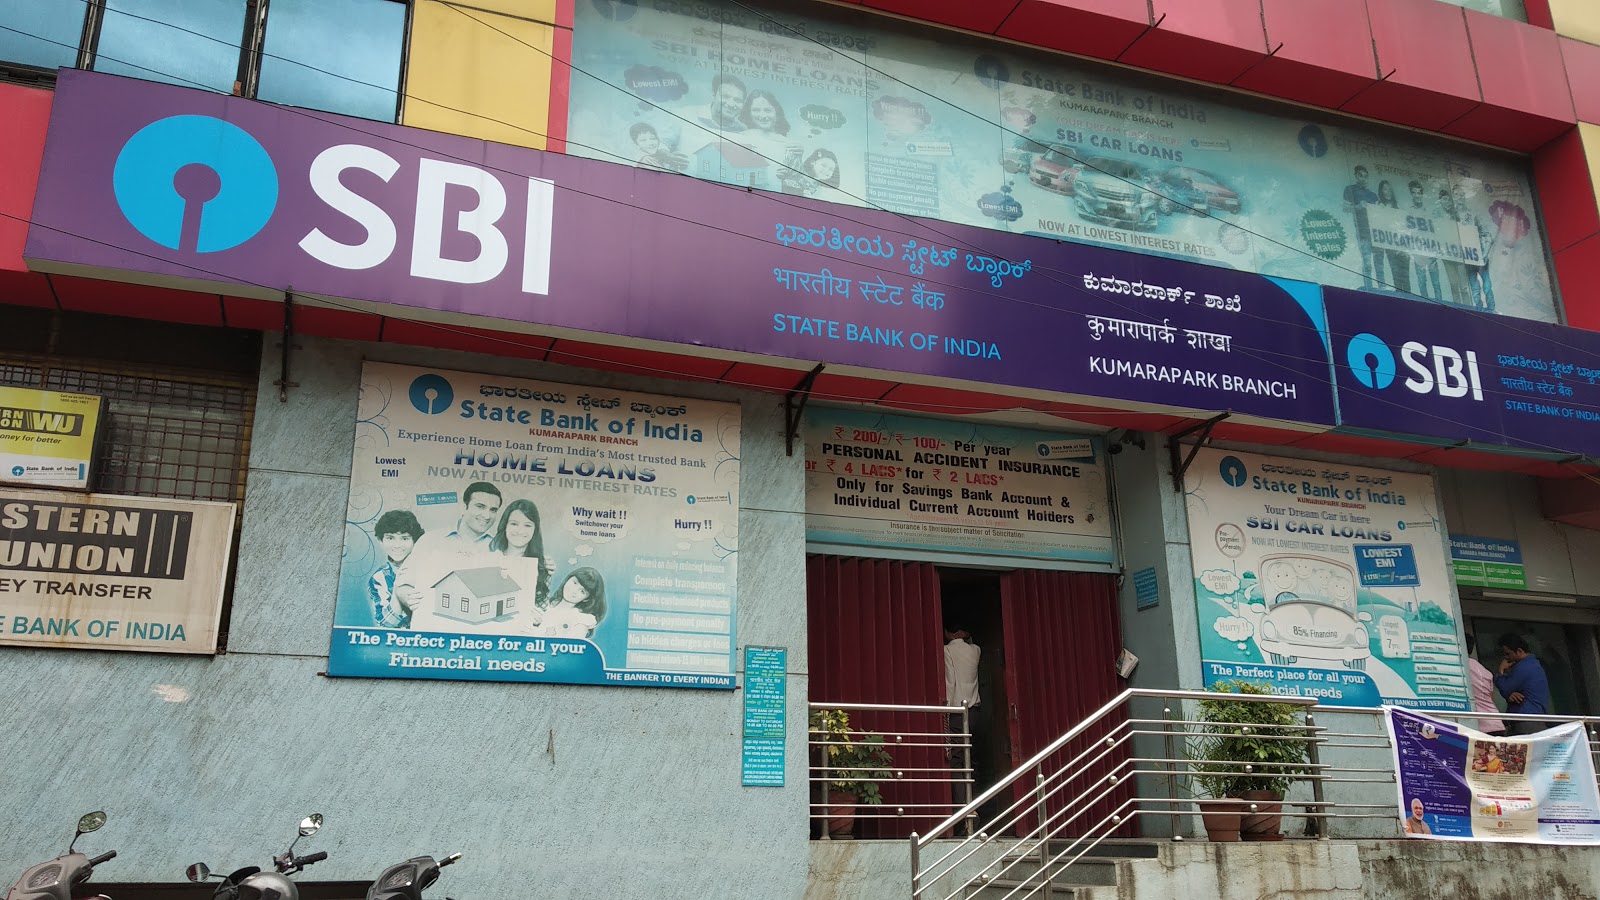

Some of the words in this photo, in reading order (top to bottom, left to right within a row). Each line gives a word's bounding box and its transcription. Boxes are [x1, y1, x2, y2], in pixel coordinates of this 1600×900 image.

[708, 49, 787, 73] HOME
[796, 66, 881, 91] LOANS
[714, 63, 768, 80] LOWEST
[771, 75, 831, 91] INTEREST
[835, 86, 874, 98] RATES
[1022, 70, 1077, 97] State
[1082, 82, 1128, 107] Bank
[1134, 95, 1154, 111] of
[1161, 101, 1206, 123] India
[807, 112, 830, 123] Hurry
[1056, 128, 1083, 144] SBI
[1090, 135, 1122, 151] CAR
[1129, 142, 1183, 163] LOANS
[298, 143, 555, 296] SBI
[1304, 219, 1336, 229] Lowest
[1307, 229, 1341, 240] Interest
[1373, 228, 1443, 251] EDUCATIONAL
[1446, 243, 1479, 262] LOANS
[775, 223, 894, 259] ಭಾರತೀಯ
[902, 240, 958, 275] ಸ್ಟೇಟ್
[965, 253, 1032, 289] ಬ್ಯಾಂಕ್
[1316, 242, 1341, 253] Rates
[774, 267, 852, 299] भारतीय
[859, 275, 905, 307] स्टेट
[911, 281, 945, 311] बैंक
[1204, 293, 1243, 313] ಶಾಖೆ
[773, 313, 840, 339] STATE
[846, 323, 904, 348] BANK
[909, 332, 939, 351] OF
[944, 336, 1002, 361] INDIA
[1183, 328, 1233, 353] शाखा
[1089, 356, 1219, 389] KUMARAPARK
[1223, 374, 1297, 400] BRANCH
[1401, 341, 1484, 401] SBI
[480, 384, 566, 404] ಭಾರತೀಯ
[577, 394, 621, 411] ಸ್ಟೇಟ್
[631, 402, 687, 418] ಬ್ಯಾಂಕ್
[1505, 400, 1534, 414] STATE
[1535, 404, 1561, 417] BANK
[1562, 407, 1575, 418] OF
[1576, 410, 1600, 422] INDIA
[32, 411, 76, 433] WU
[460, 400, 531, 425] State
[540, 408, 599, 432] Bank
[608, 417, 635, 435] of
[644, 420, 703, 442] India
[22, 434, 34, 442] for
[36, 435, 62, 445] better
[398, 429, 465, 446] Experience
[468, 436, 502, 448] Home
[505, 438, 533, 451] Loan
[536, 442, 563, 454] from
[567, 446, 605, 458] India's
[608, 451, 635, 462] Most
[638, 455, 677, 466] trusted
[680, 457, 707, 468] Bank
[529, 428, 597, 443] KUMARAPARK
[600, 435, 639, 447] BRANCH
[835, 426, 845, 439] ₹
[913, 436, 945, 450] 100/-
[954, 440, 976, 453] Per
[984, 445, 1011, 456] year
[375, 456, 406, 465] Lowest
[454, 448, 548, 473] HOME
[557, 457, 657, 483] LOANS
[822, 442, 904, 462] PERSONAL
[913, 451, 988, 469] ACCIDENT
[998, 459, 1081, 478] INSURANCE
[381, 469, 399, 478] EMI
[428, 465, 466, 479] NOW
[469, 469, 489, 481] AT
[492, 472, 555, 487] LOWEST
[559, 477, 630, 494] INTEREST
[633, 485, 678, 498] RATES
[837, 477, 866, 492] Only
[875, 481, 894, 493] for
[902, 482, 953, 499] Savings
[961, 488, 993, 501] Bank
[1001, 491, 1052, 507] Account
[1061, 497, 1070, 508] &
[1252, 476, 1297, 495] State
[1302, 482, 1339, 499] Bank
[1344, 487, 1362, 502] of
[1368, 490, 1406, 506] India
[1, 502, 141, 537] STERN
[572, 506, 593, 519] Why
[595, 510, 617, 519] wait
[619, 510, 627, 520] !!
[834, 493, 900, 510] Individual
[909, 499, 958, 515] Current
[967, 504, 1019, 520] Account
[1027, 509, 1075, 524] Holders
[674, 519, 701, 531] Hurry
[704, 520, 712, 530] !!
[890, 522, 920, 531] Insurance
[963, 528, 983, 536] matter
[993, 529, 1025, 538] Solicitation
[1246, 515, 1279, 531] SBI
[1285, 520, 1325, 536] CAR
[1331, 525, 1392, 542] LOANS
[0, 540, 135, 574] UNION
[1225, 543, 1242, 551] Penalty
[1362, 548, 1402, 558] LOWEST
[1469, 542, 1486, 550] Bank
[1376, 559, 1396, 568] EMI
[33, 580, 152, 600] TRANSFER
[635, 575, 673, 588] Complete
[675, 578, 726, 592] transparency
[1208, 574, 1232, 582] Lowest
[12, 616, 82, 637] BANK
[87, 620, 119, 639] OF
[126, 622, 187, 642] INDIA
[1293, 625, 1309, 637] 85%
[1311, 629, 1338, 639] Financing
[348, 631, 380, 645] The
[385, 633, 445, 648] Perfect
[450, 636, 493, 653] place
[498, 637, 520, 651] for
[525, 639, 545, 653] all
[550, 643, 586, 656] your
[388, 652, 482, 671] Financial
[487, 657, 546, 673] needs
[1211, 664, 1232, 675] The
[1235, 665, 1275, 678] Perfect
[1277, 669, 1305, 682] place
[1308, 670, 1323, 681] for
[1326, 671, 1340, 683] all
[1343, 673, 1366, 684] your
[606, 672, 622, 681] THE
[624, 674, 659, 682] BANKER
[661, 674, 672, 683] TO
[673, 675, 700, 684] EVERY
[701, 676, 730, 685] INDIAN
